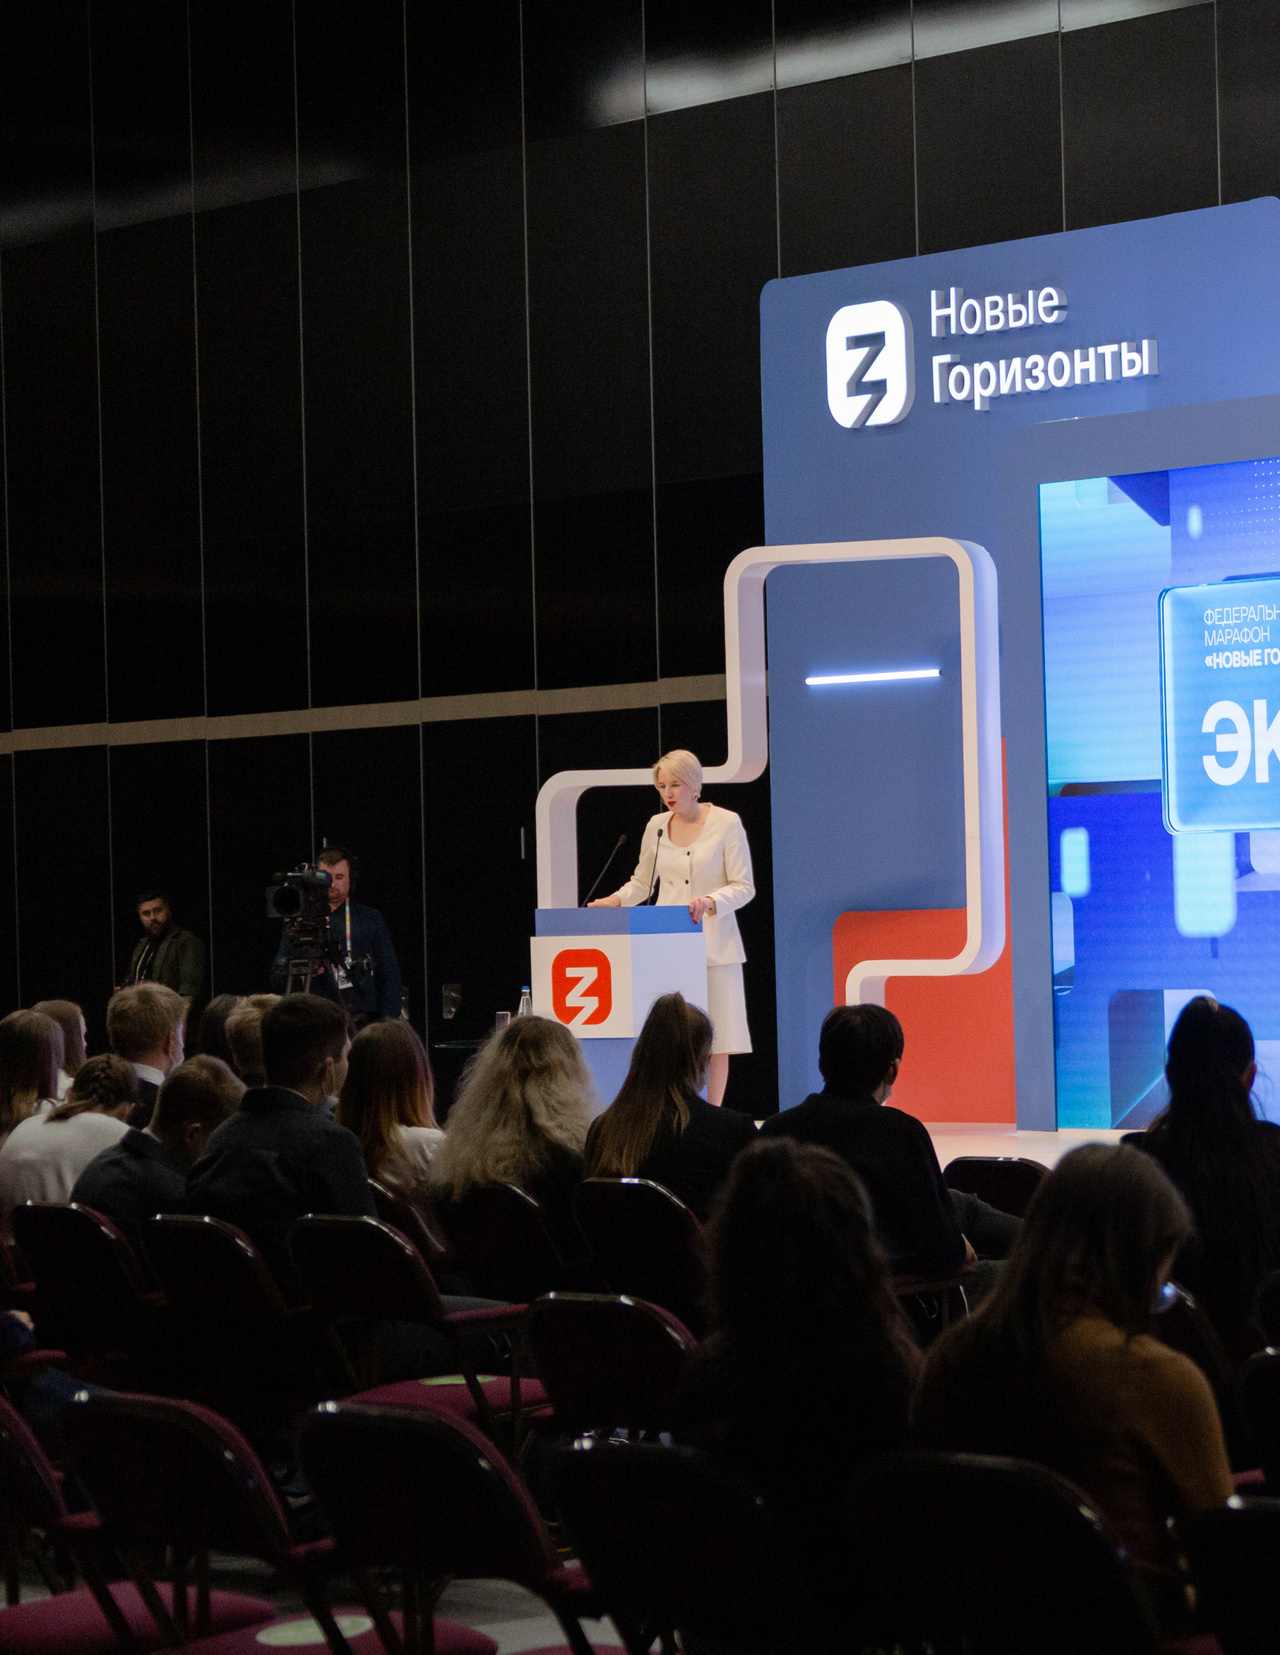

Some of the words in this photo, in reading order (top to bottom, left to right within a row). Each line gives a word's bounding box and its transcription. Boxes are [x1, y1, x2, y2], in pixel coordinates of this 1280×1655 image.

[930, 287, 1067, 337] Новые
[930, 338, 1159, 411] Горизонты
[1204, 626, 1270, 646] МАРАФОН
[1204, 649, 1263, 669] «НОВЫЕ
